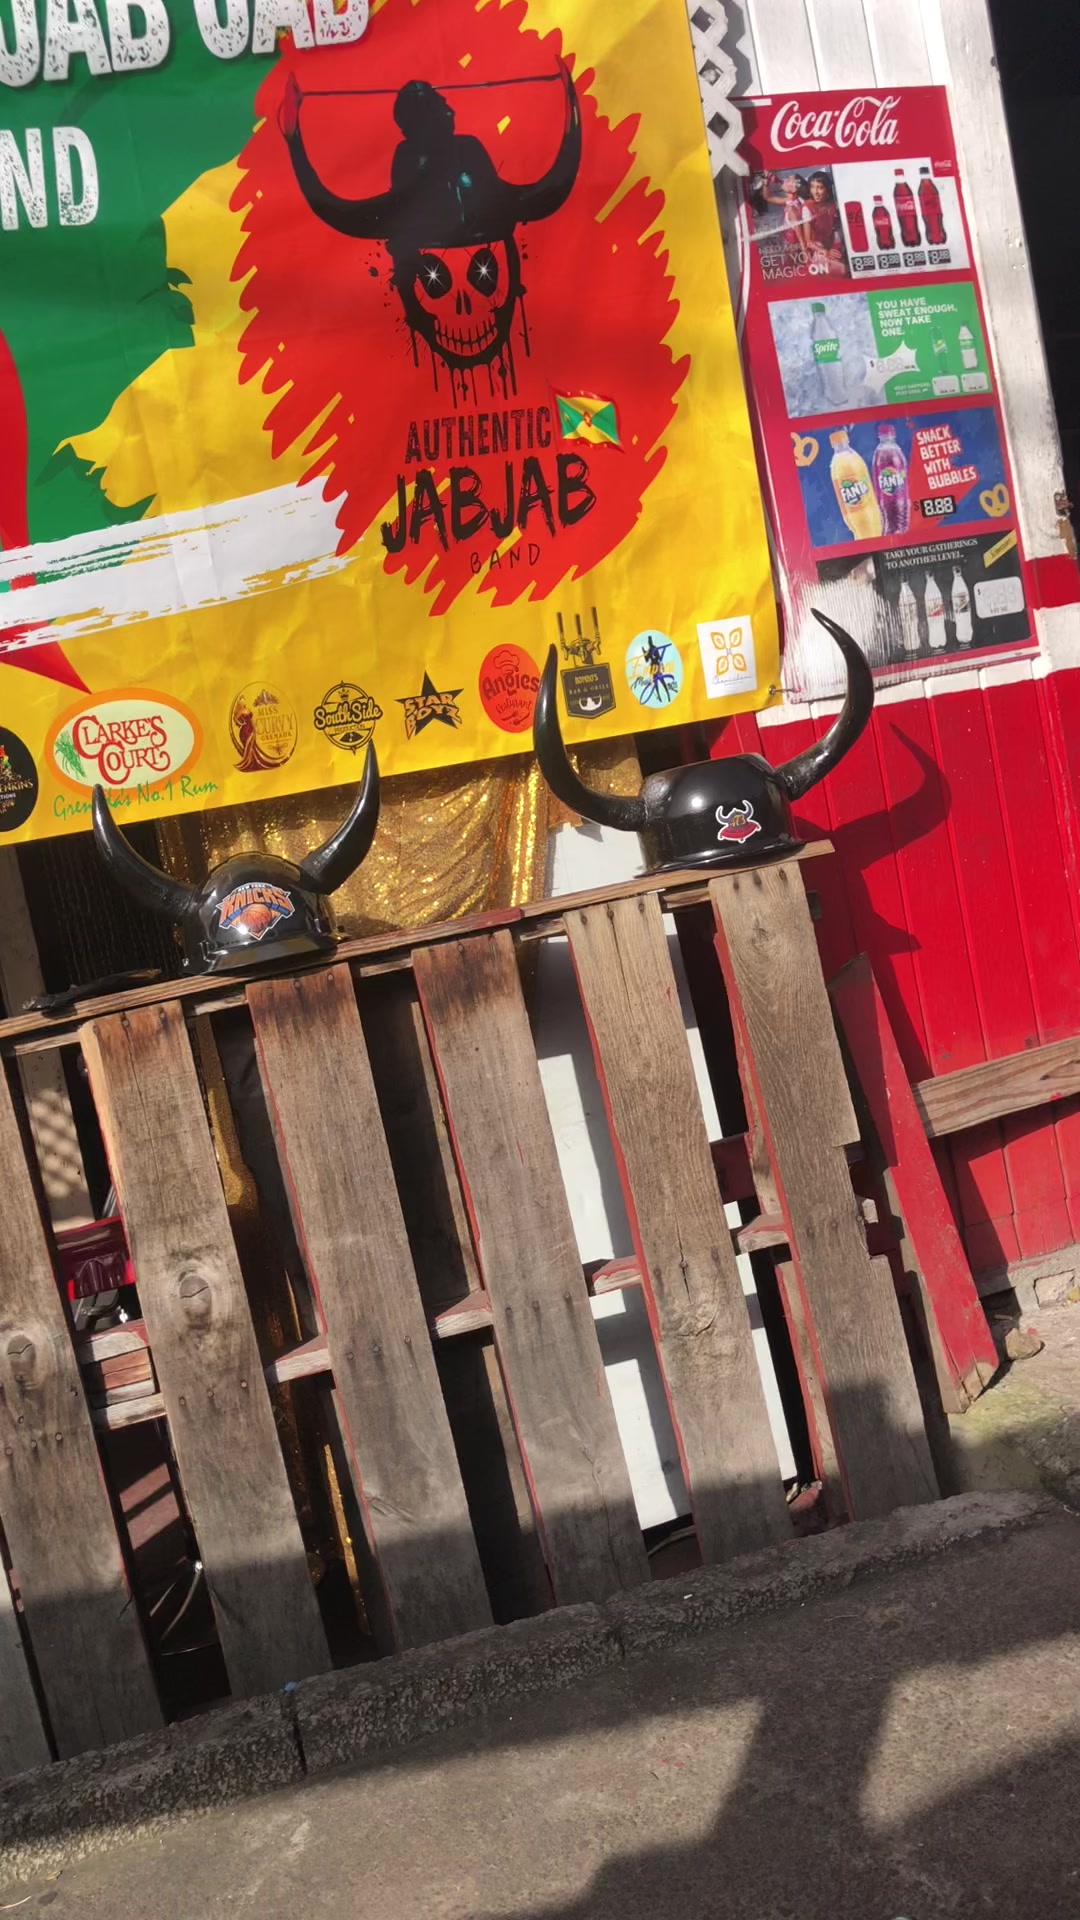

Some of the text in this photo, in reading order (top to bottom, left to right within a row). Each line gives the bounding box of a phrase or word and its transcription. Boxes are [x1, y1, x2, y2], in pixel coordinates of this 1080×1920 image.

[770, 95, 901, 153] Coca-Cola
[760, 253, 786, 268] GET
[761, 262, 830, 281] MAGIC ON
[876, 296, 927, 311] YOU HAVE
[879, 314, 932, 329] NOW TAKE
[813, 341, 839, 354] Sprite
[405, 406, 551, 464] AUTHENTIC
[916, 424, 952, 446] SNACK
[920, 438, 962, 461] BETTER
[923, 457, 951, 475] WITH
[927, 465, 977, 490] BUBBLES
[469, 542, 541, 574] BAND
[884, 549, 906, 560] TAKE
[905, 546, 928, 557] YOUR
[928, 537, 979, 552] GATHERINGS
[886, 560, 898, 570] TO
[898, 555, 938, 569] ANOTHER
[482, 673, 540, 701] Angies
[72, 715, 168, 759] CLARKE'S
[99, 739, 171, 785] COURT
[53, 790, 131, 820] Grenda's
[180, 774, 218, 797] Rum
[219, 887, 293, 925] KNICKS
